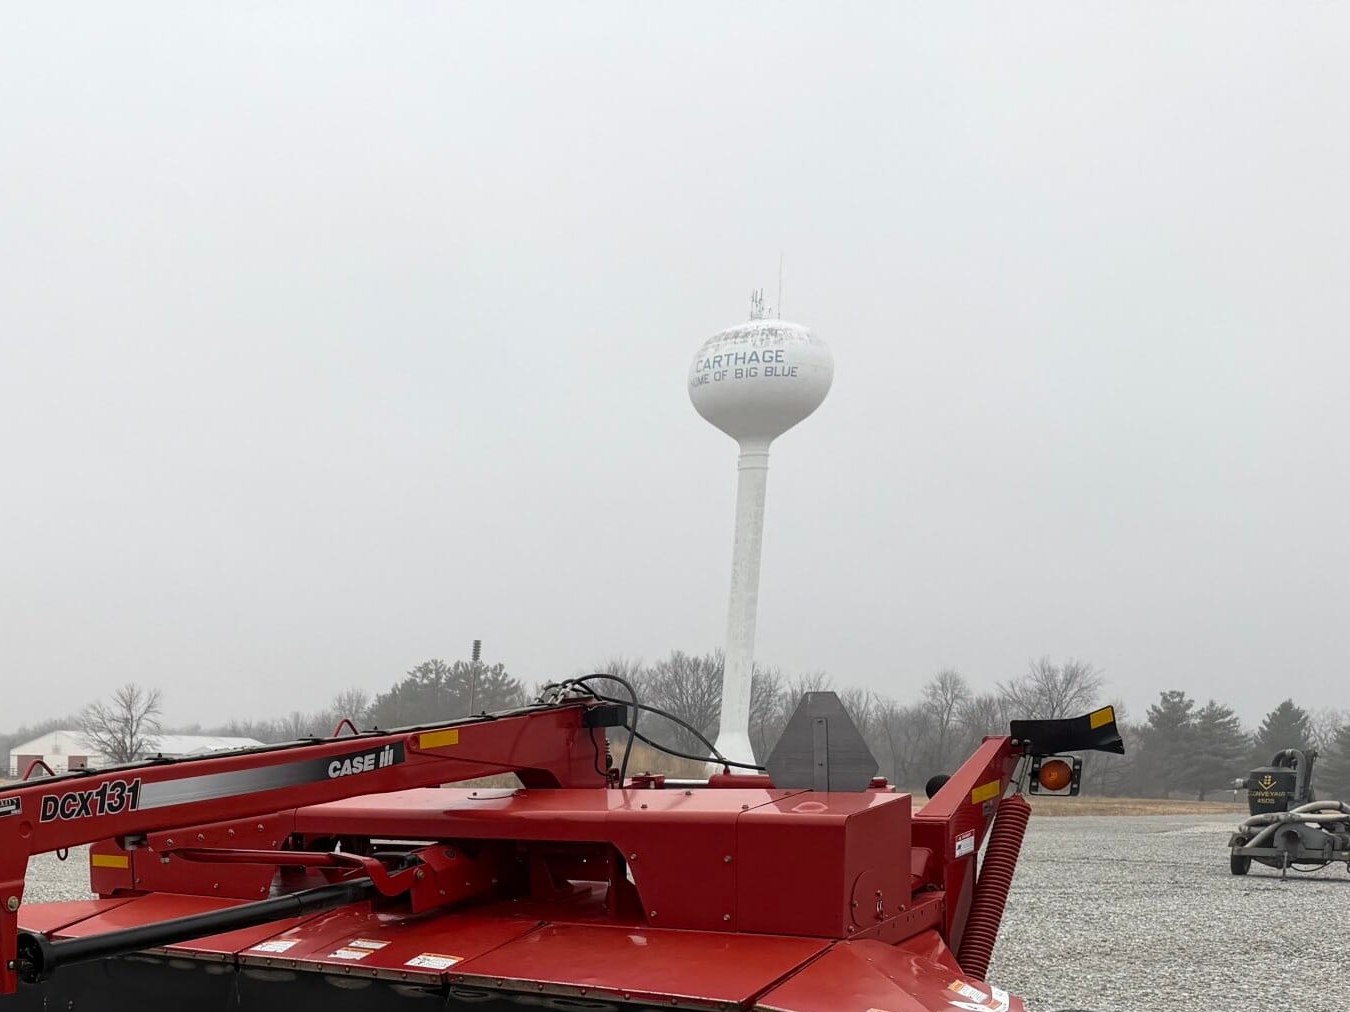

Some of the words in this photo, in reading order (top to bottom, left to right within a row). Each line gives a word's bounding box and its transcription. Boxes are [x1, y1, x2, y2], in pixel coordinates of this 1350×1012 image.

[696, 350, 785, 373] CARTHAGE
[713, 369, 728, 382] OF
[734, 367, 759, 379] BIG
[764, 366, 799, 378] BLUE
[328, 753, 376, 778] CASE
[39, 777, 142, 823] DCX131
